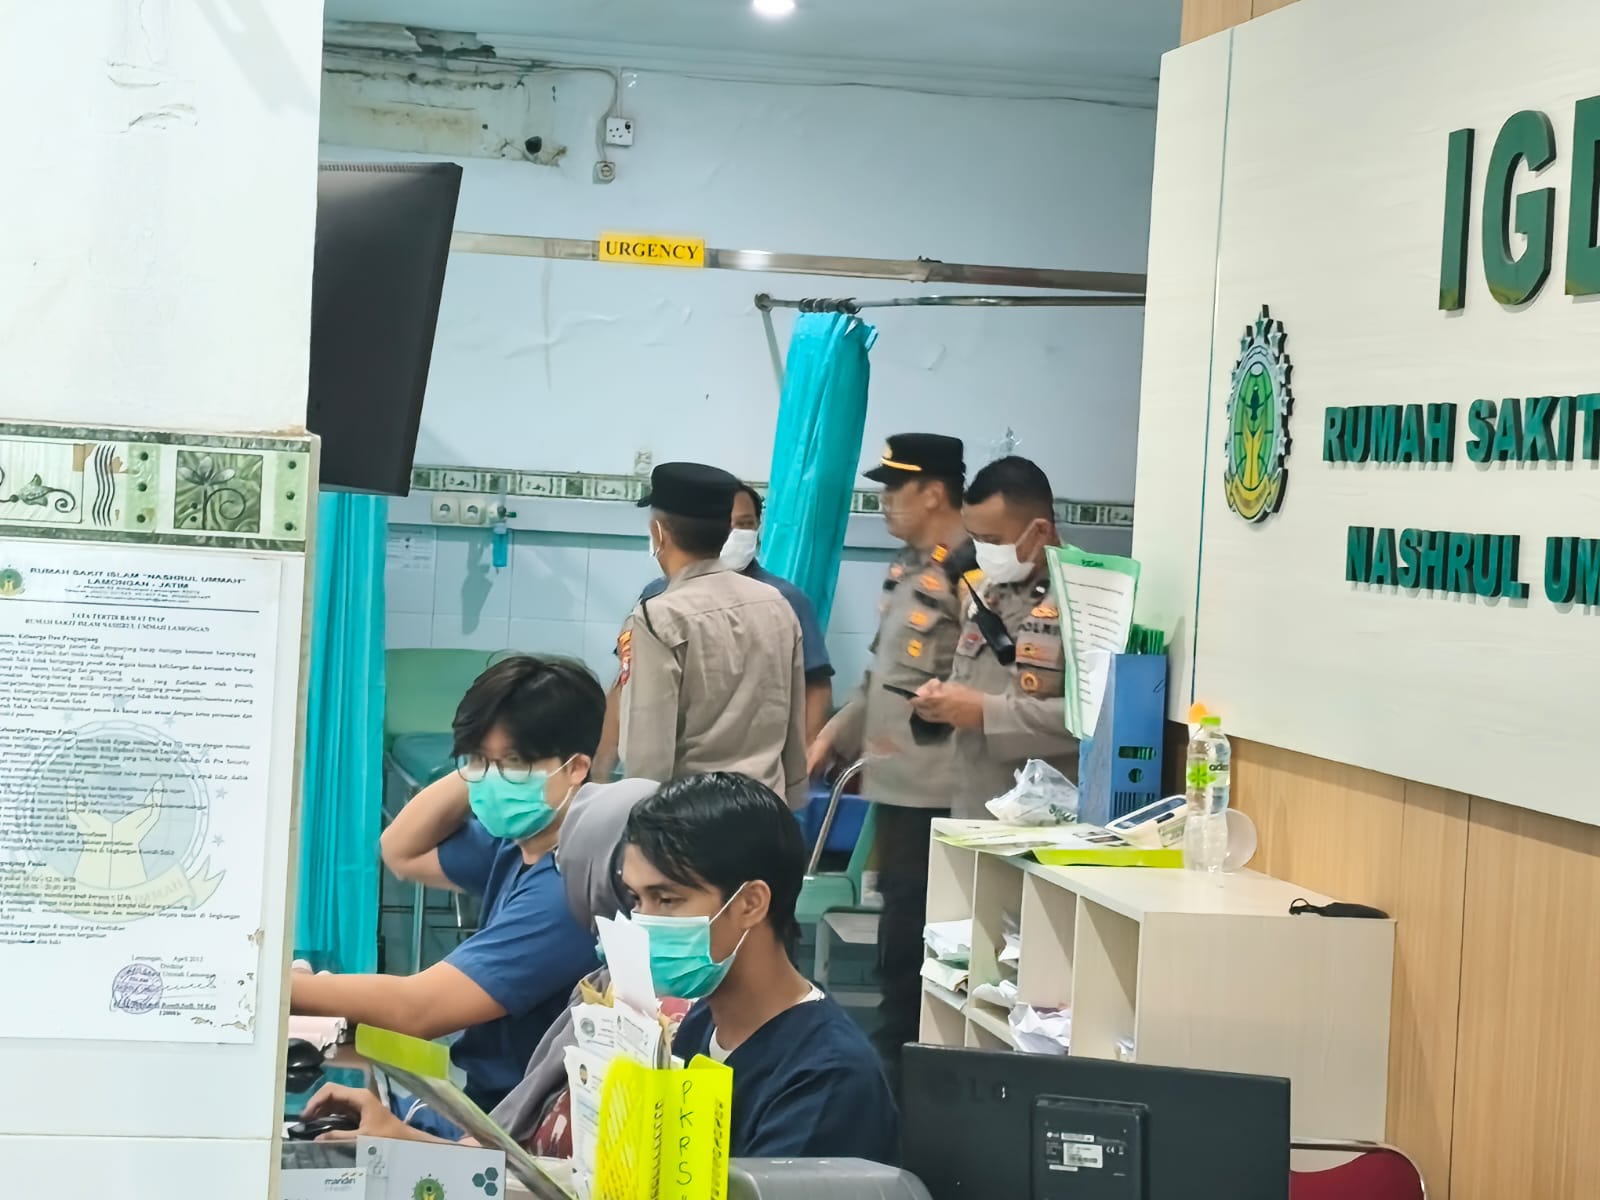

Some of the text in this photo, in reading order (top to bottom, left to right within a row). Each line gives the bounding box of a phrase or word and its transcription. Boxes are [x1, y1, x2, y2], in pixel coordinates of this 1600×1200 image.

[605, 241, 699, 260] URGENCY
[1323, 393, 1600, 463] RUMAH SAKIT
[1346, 526, 1530, 600] NASHRUL
[30, 567, 70, 575] RUMAH
[73, 569, 103, 577] SAKIT
[106, 571, 140, 579] ISLAM
[87, 579, 149, 587] LAMONGAN
